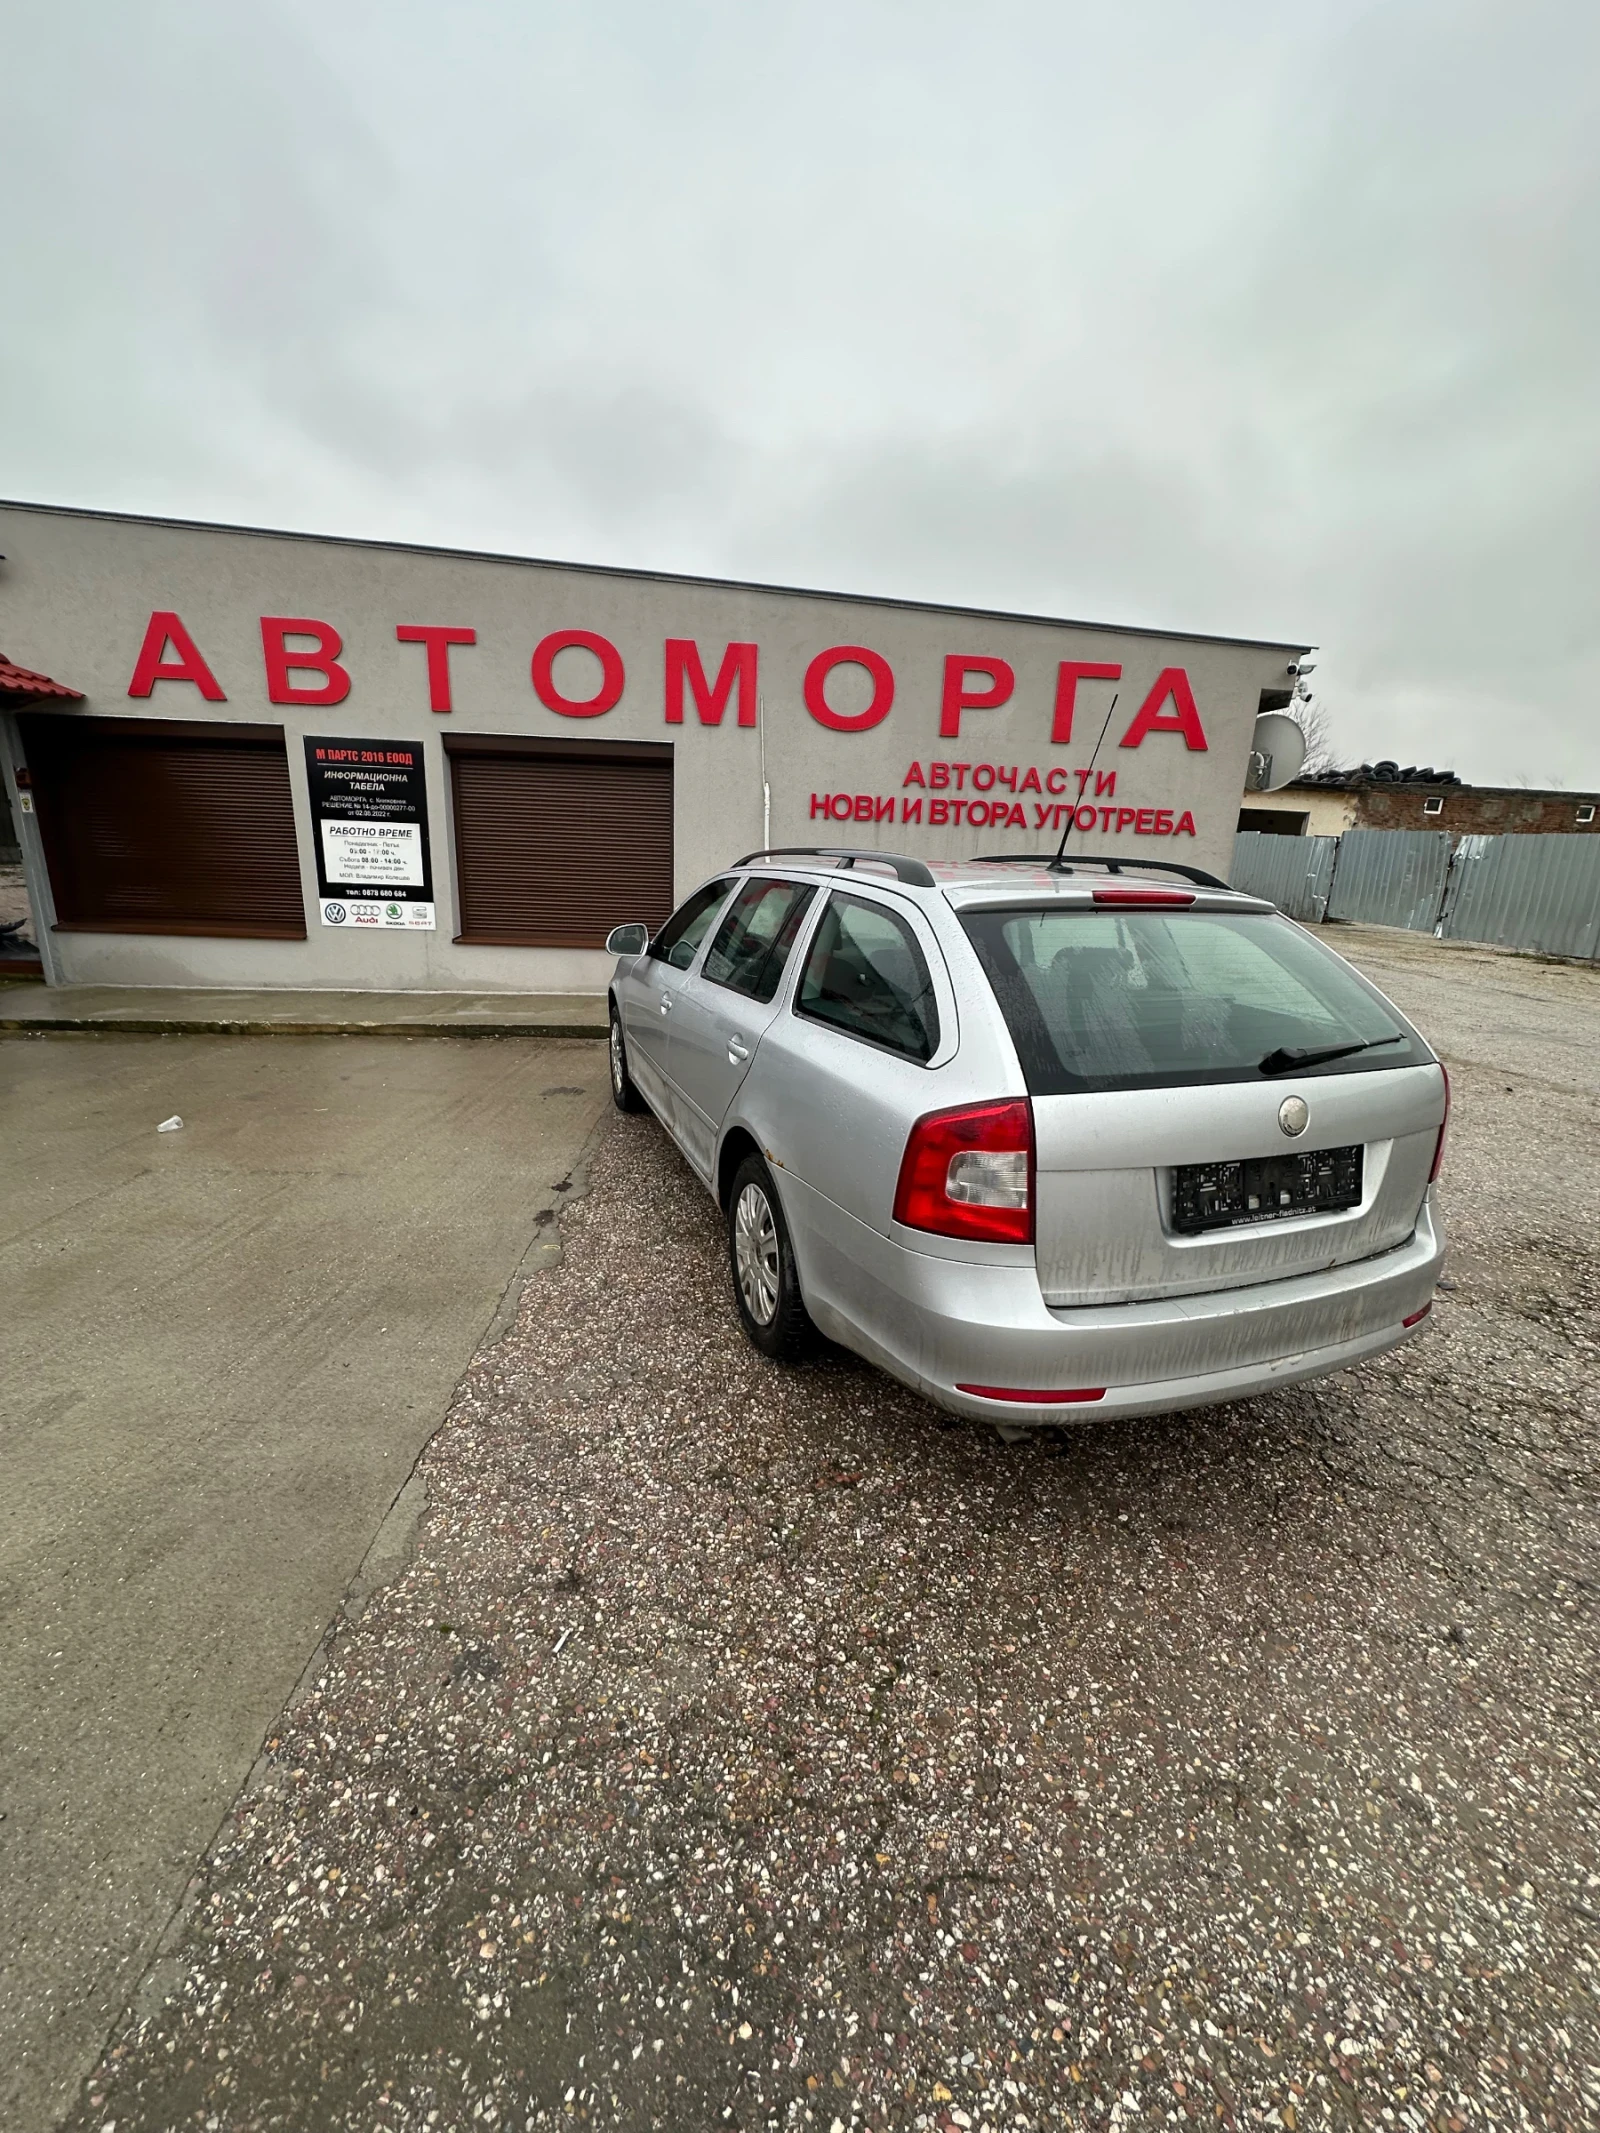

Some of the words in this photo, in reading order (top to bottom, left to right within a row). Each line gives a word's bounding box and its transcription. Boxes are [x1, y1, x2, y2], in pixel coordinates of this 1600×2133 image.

[127, 610, 1208, 751] АВТОМОРГА
[315, 748, 325, 759] М
[327, 749, 359, 761] ПАРТС
[361, 751, 385, 763] 2016
[386, 752, 413, 765] ЕООД
[324, 770, 408, 782] ИНФОРМАЦИОННА
[903, 761, 1117, 796] АВТОЧАСТИ
[349, 782, 385, 791] ТАБЕЛА
[809, 793, 895, 822] НОВИ
[901, 797, 923, 824] И
[928, 799, 1028, 828] ВТОРА
[1034, 803, 1197, 837] УПОТРЕБА
[329, 826, 376, 835] РАБОТНО
[378, 828, 412, 837] ВРЕМЕ
[355, 916, 379, 924] Audi
